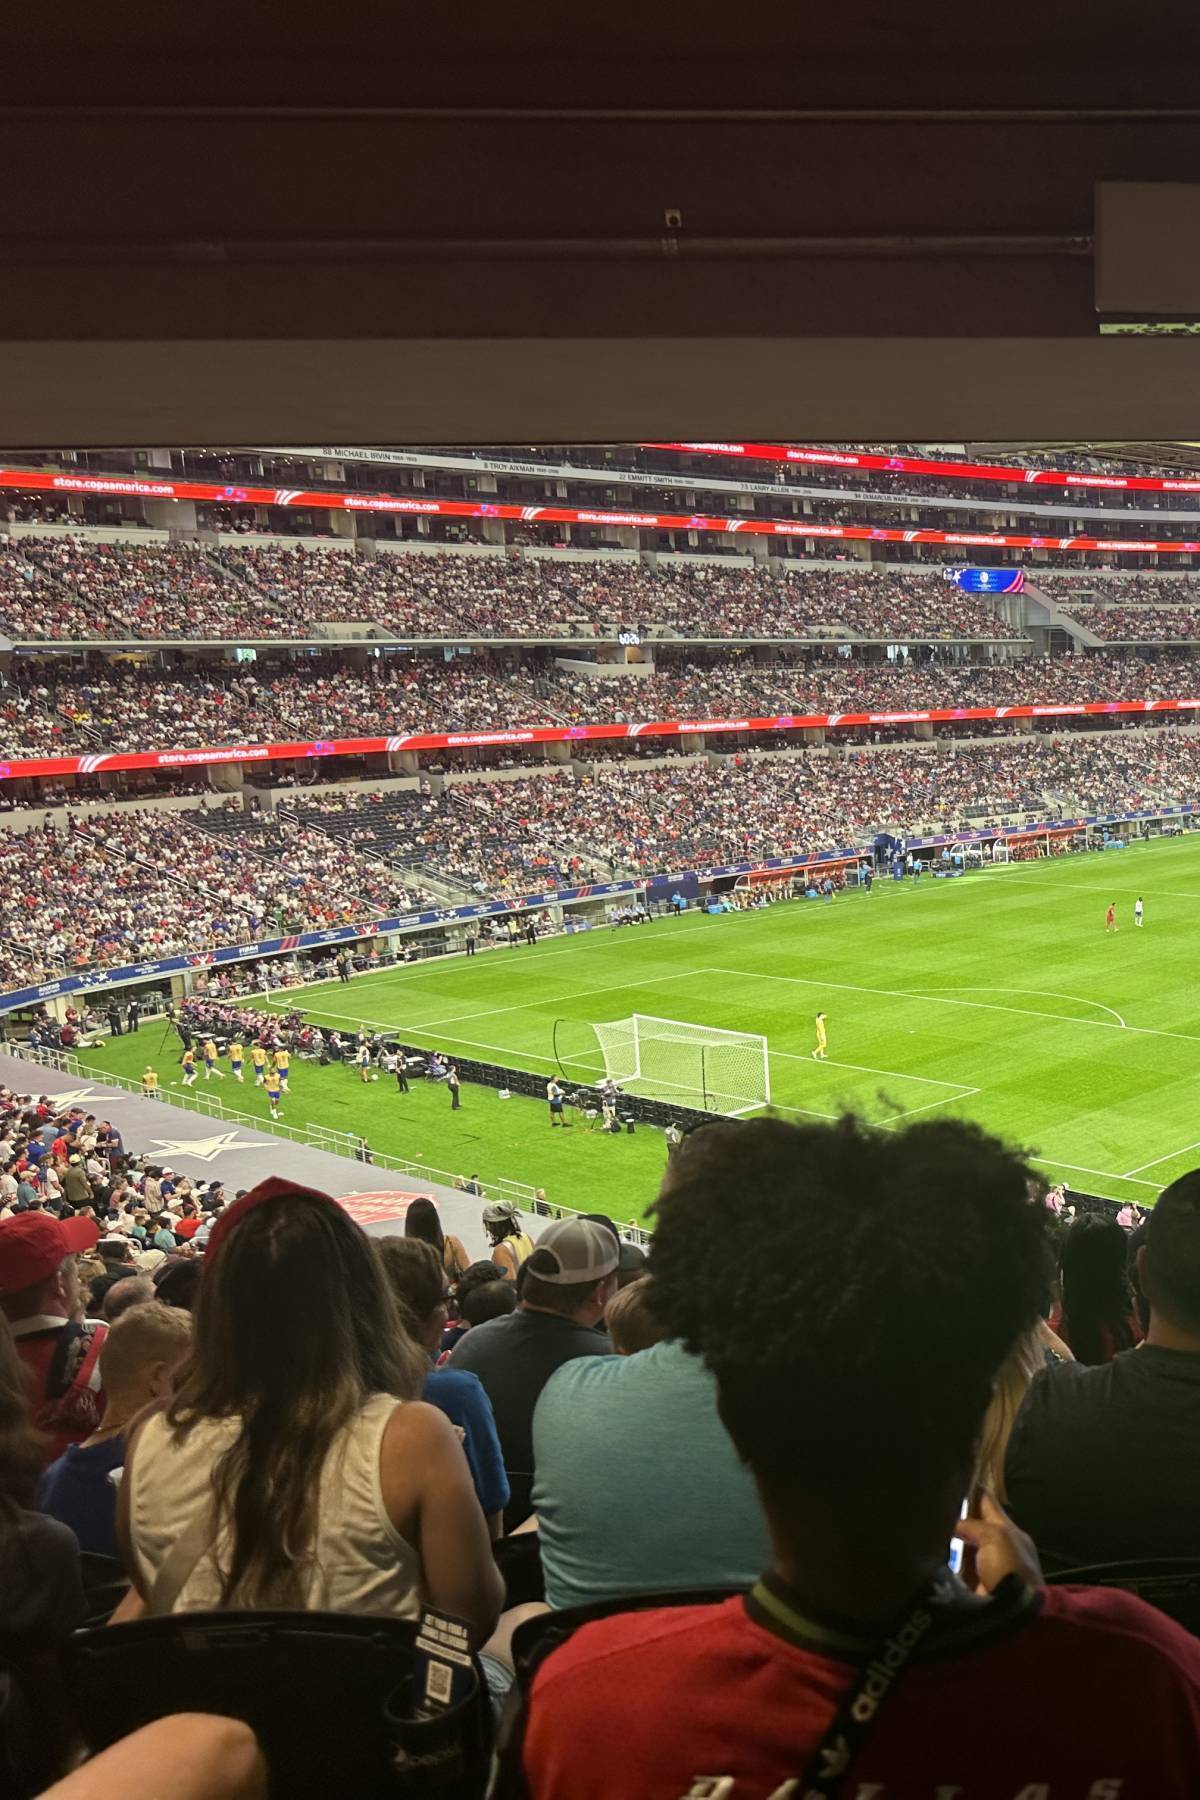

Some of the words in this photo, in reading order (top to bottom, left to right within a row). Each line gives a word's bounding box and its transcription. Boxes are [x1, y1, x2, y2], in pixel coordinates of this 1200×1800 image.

[334, 450, 369, 459] MICHAEL
[53, 478, 174, 494] store.copaamerica.com
[653, 476, 673, 484] SMITH
[344, 498, 440, 512] store.copaamerica.com
[447, 732, 533, 744] store.copaamerica.com
[158, 748, 269, 764] store.copaamerica.com
[850, 1609, 934, 1723] adidas
